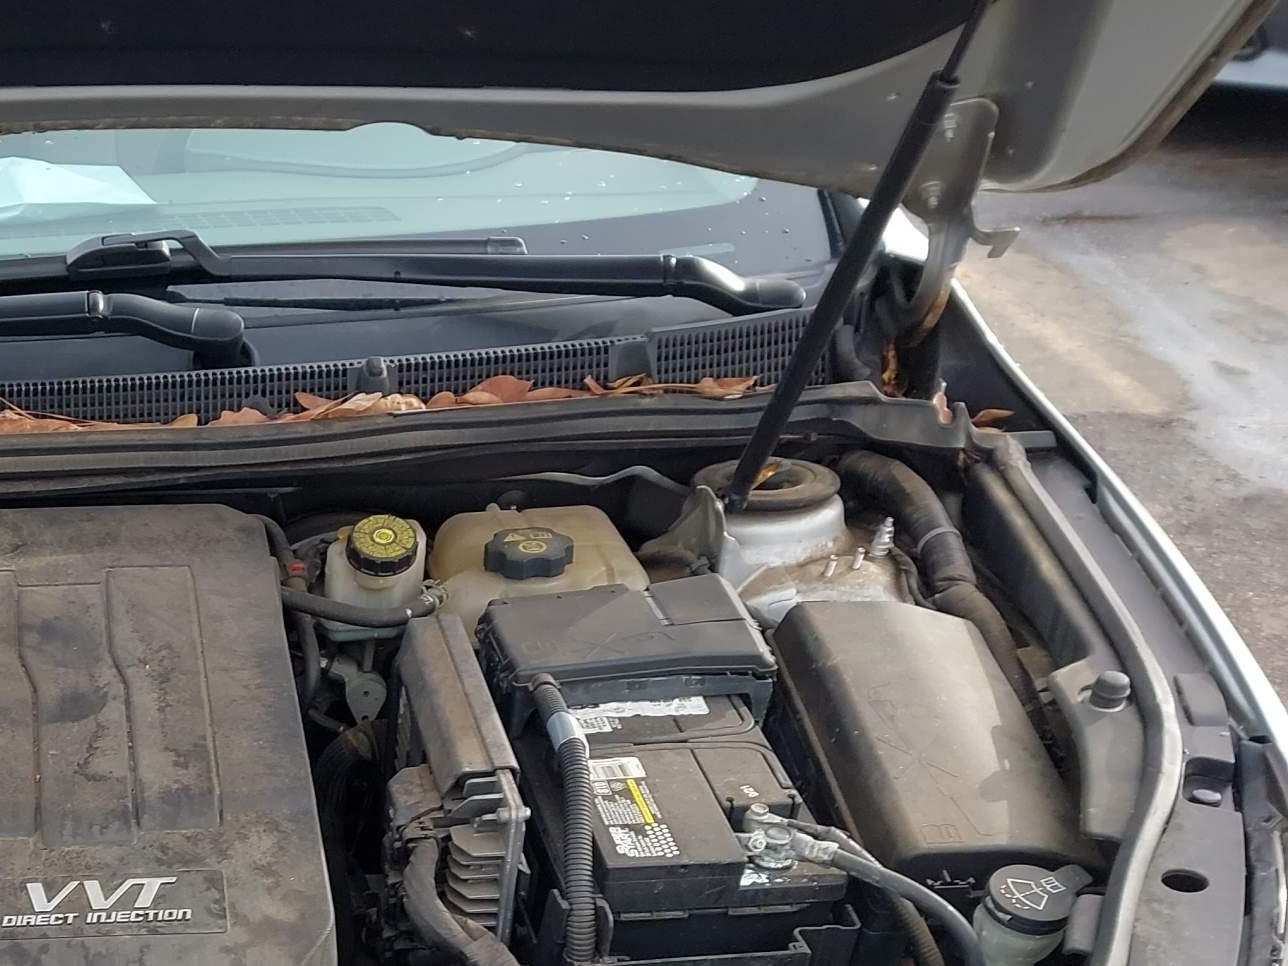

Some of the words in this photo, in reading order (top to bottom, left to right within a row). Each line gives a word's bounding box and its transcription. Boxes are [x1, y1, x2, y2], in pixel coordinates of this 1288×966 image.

[26, 876, 177, 912] VVT
[1, 912, 79, 928] DIRECT
[85, 908, 192, 925] INJECTION
